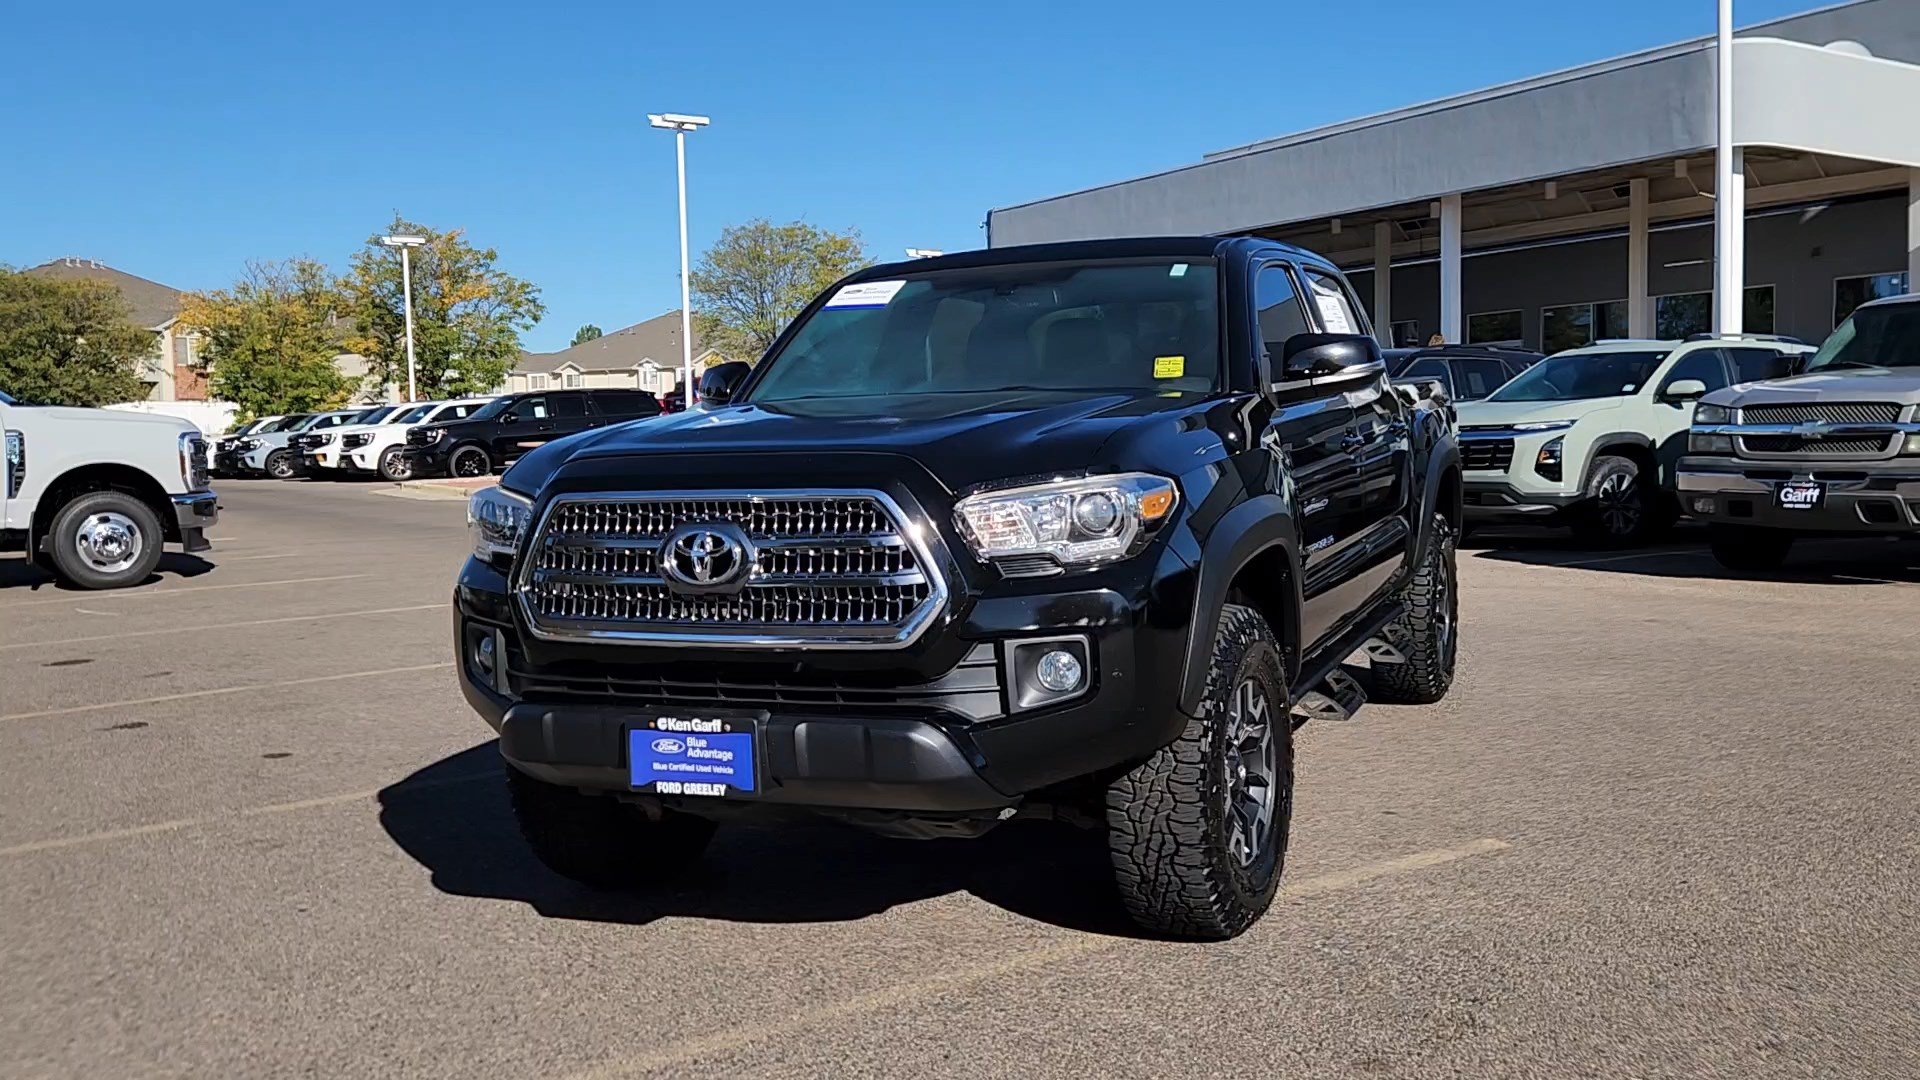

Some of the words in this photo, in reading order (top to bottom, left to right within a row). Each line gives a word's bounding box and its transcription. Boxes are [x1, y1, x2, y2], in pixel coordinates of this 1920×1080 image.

[1780, 487, 1820, 502] Garff
[686, 737, 708, 748] Blue
[686, 748, 733, 761] Advantage
[652, 762, 668, 771] Blue
[669, 763, 695, 772] Certified
[695, 764, 712, 773] Used
[712, 766, 734, 775] Vehicle
[656, 781, 682, 794] FORD
[683, 782, 726, 797] GREELEY
